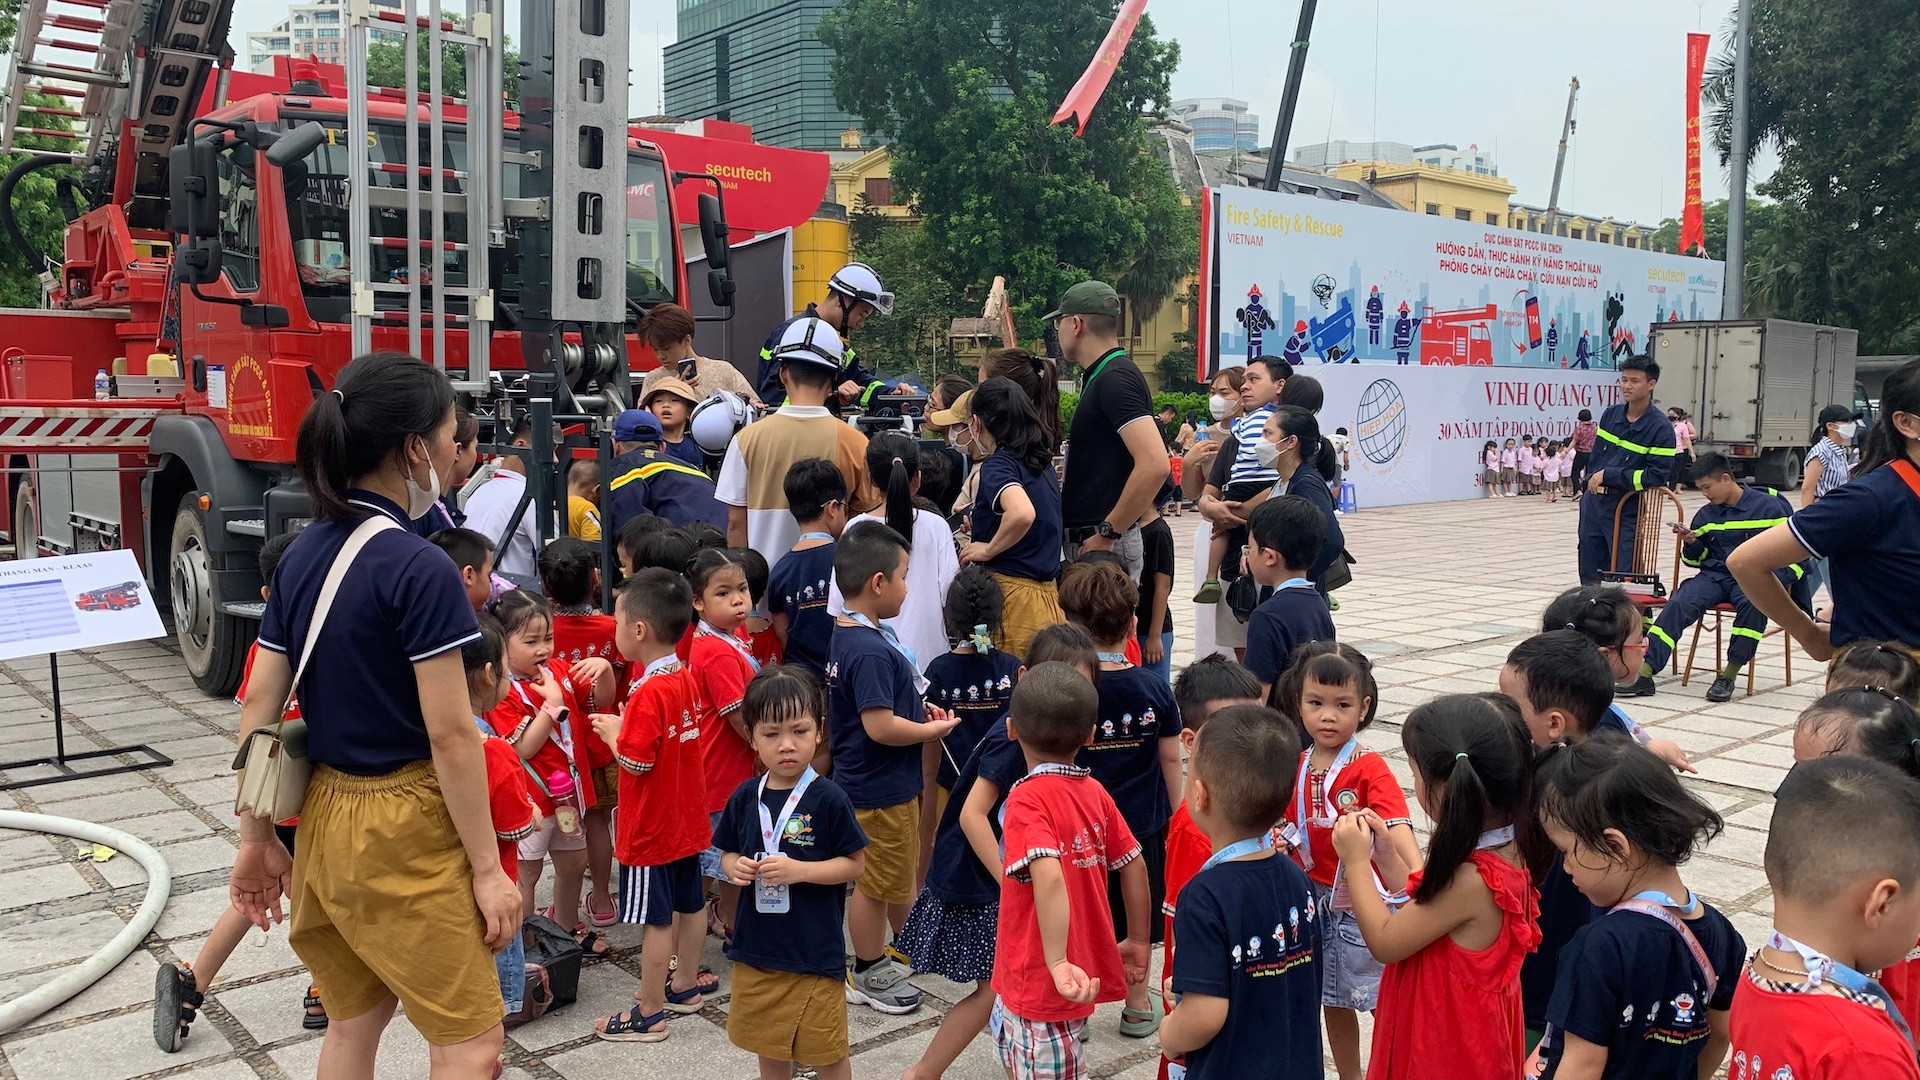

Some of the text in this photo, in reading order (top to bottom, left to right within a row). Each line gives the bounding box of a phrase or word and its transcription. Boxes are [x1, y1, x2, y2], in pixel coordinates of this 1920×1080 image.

[706, 164, 771, 182] secutech
[706, 179, 738, 190] VIENAM
[1226, 204, 1344, 237] Fire Safety & Rescue
[1228, 232, 1264, 247] VIETNAM
[1525, 239, 1539, 251] PCCC
[1510, 251, 1530, 265] HÀNH
[1440, 259, 1468, 273] PHÒNG
[1648, 268, 1685, 284] secutech
[1529, 315, 1539, 324] 114
[1484, 380, 1622, 411] VINH QUANG VIÊ
[1360, 420, 1381, 437] HIEP
[1383, 401, 1402, 424] HOA
[1438, 423, 1451, 440] 30
[1454, 418, 1482, 439] NĂM
[1486, 417, 1508, 441] TẬP
[1512, 417, 1544, 437] ĐOÀN
[1546, 416, 1554, 436] Ô
[1558, 416, 1571, 436] TÔ
